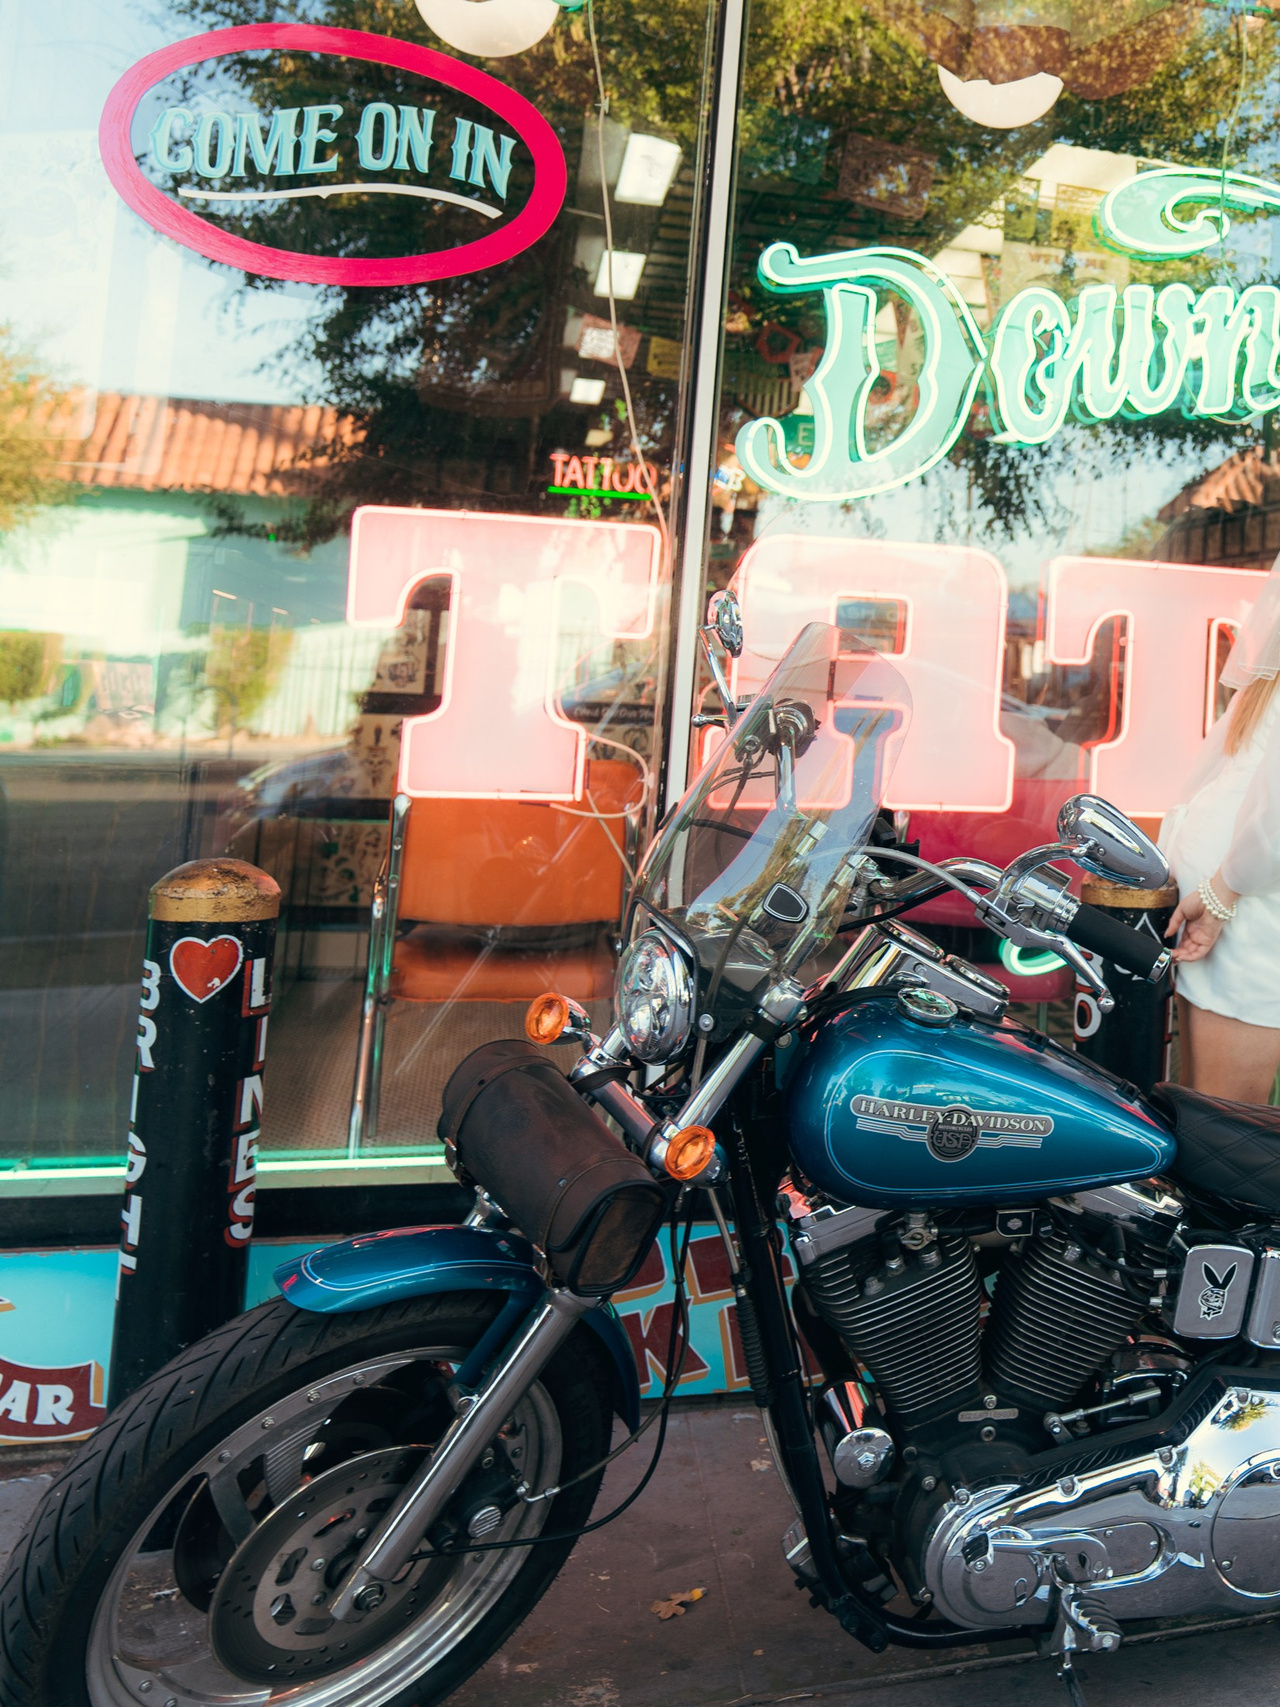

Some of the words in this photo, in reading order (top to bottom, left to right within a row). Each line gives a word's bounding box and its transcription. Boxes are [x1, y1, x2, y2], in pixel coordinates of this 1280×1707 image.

[149, 103, 344, 178] COME
[354, 102, 437, 174] ON
[449, 116, 517, 200] IN
[549, 452, 658, 494] TATTOO
[859, 1099, 1048, 1132] HARLEY-DAVIDSON
[932, 1130, 973, 1150] USA
[0, 1372, 75, 1426] AR
